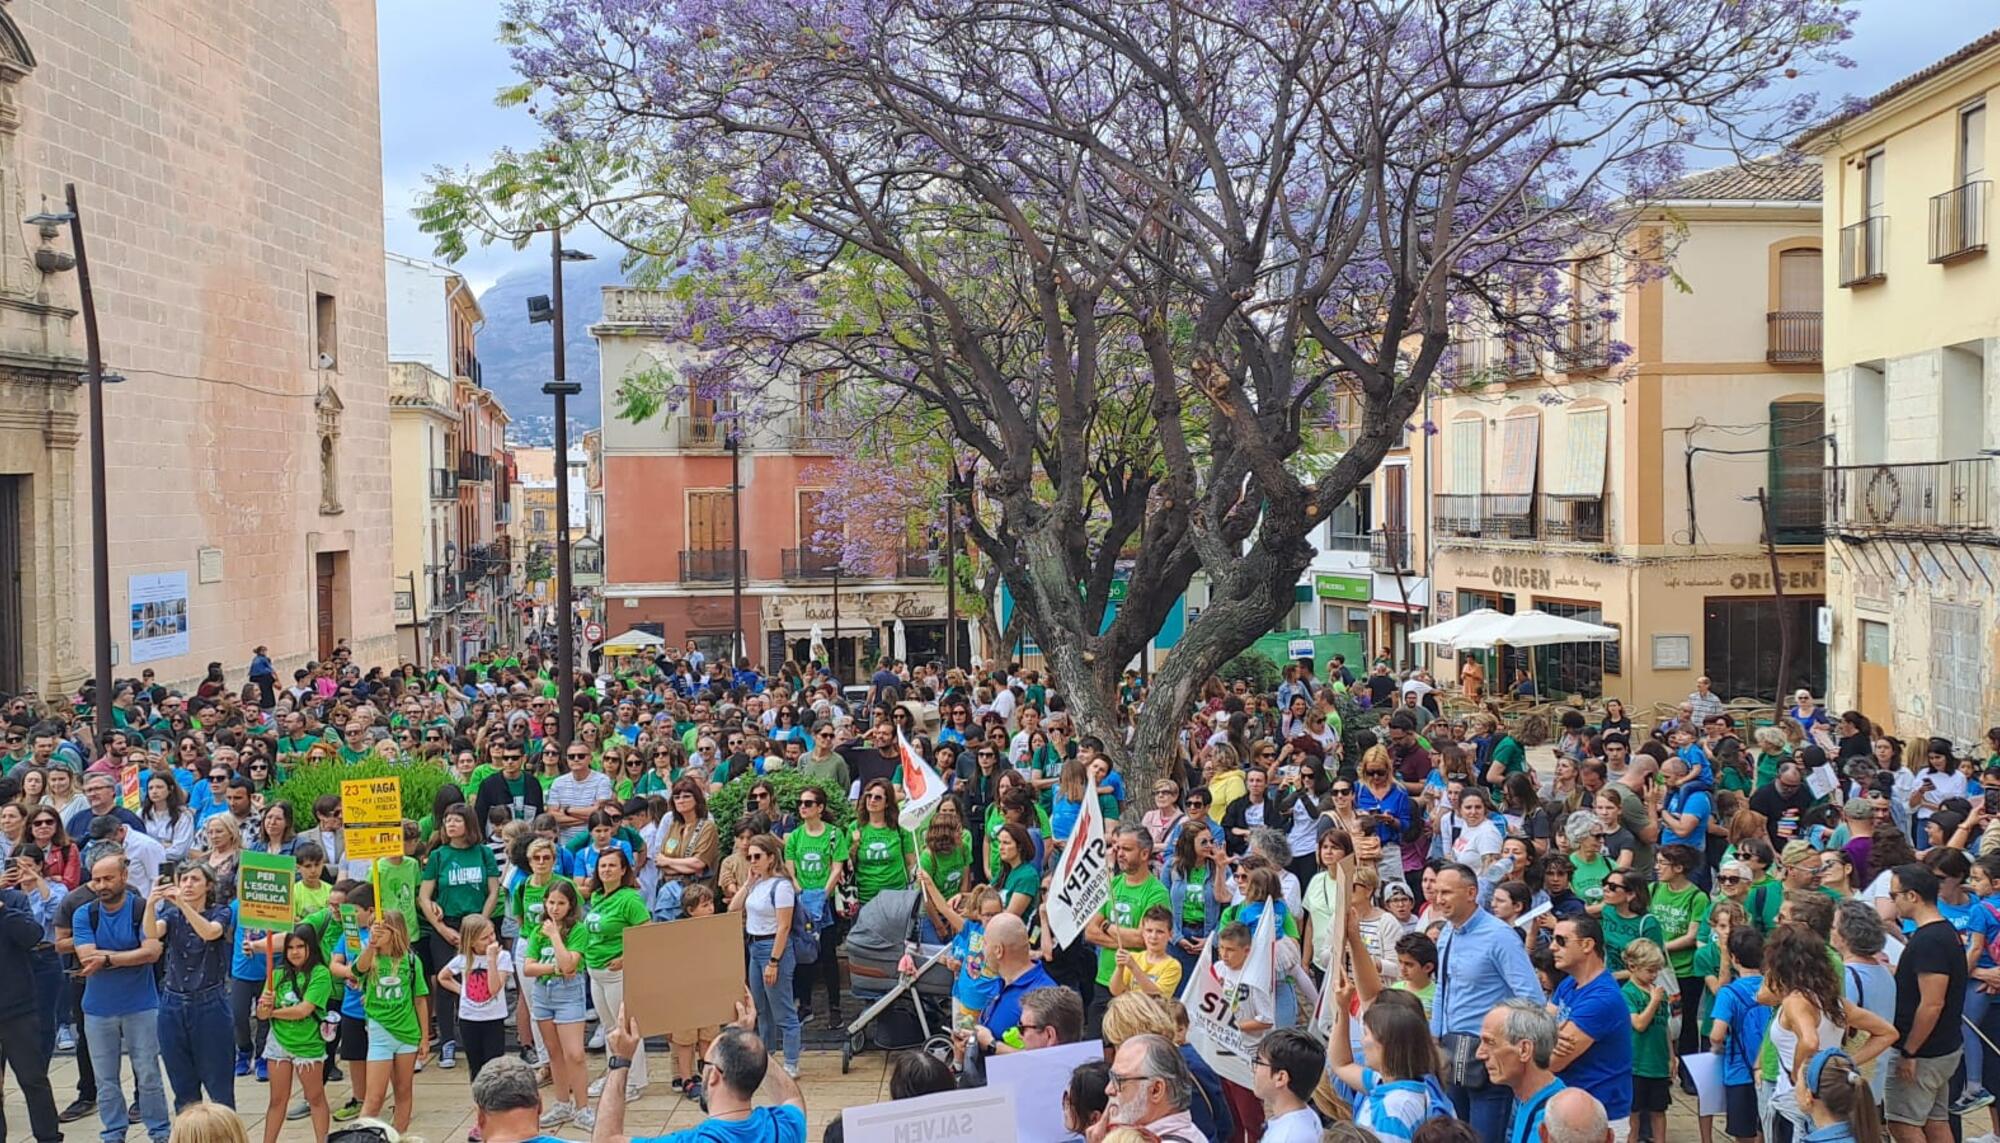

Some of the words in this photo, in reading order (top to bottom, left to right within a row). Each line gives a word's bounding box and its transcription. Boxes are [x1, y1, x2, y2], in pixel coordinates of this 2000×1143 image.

[1492, 565, 1550, 590] ORIGEN
[344, 784, 359, 797] 23
[370, 782, 395, 794] VAGA
[257, 871, 275, 881] PER
[244, 881, 287, 893] L'ESCOLA
[246, 890, 286, 903] PÚBLICA
